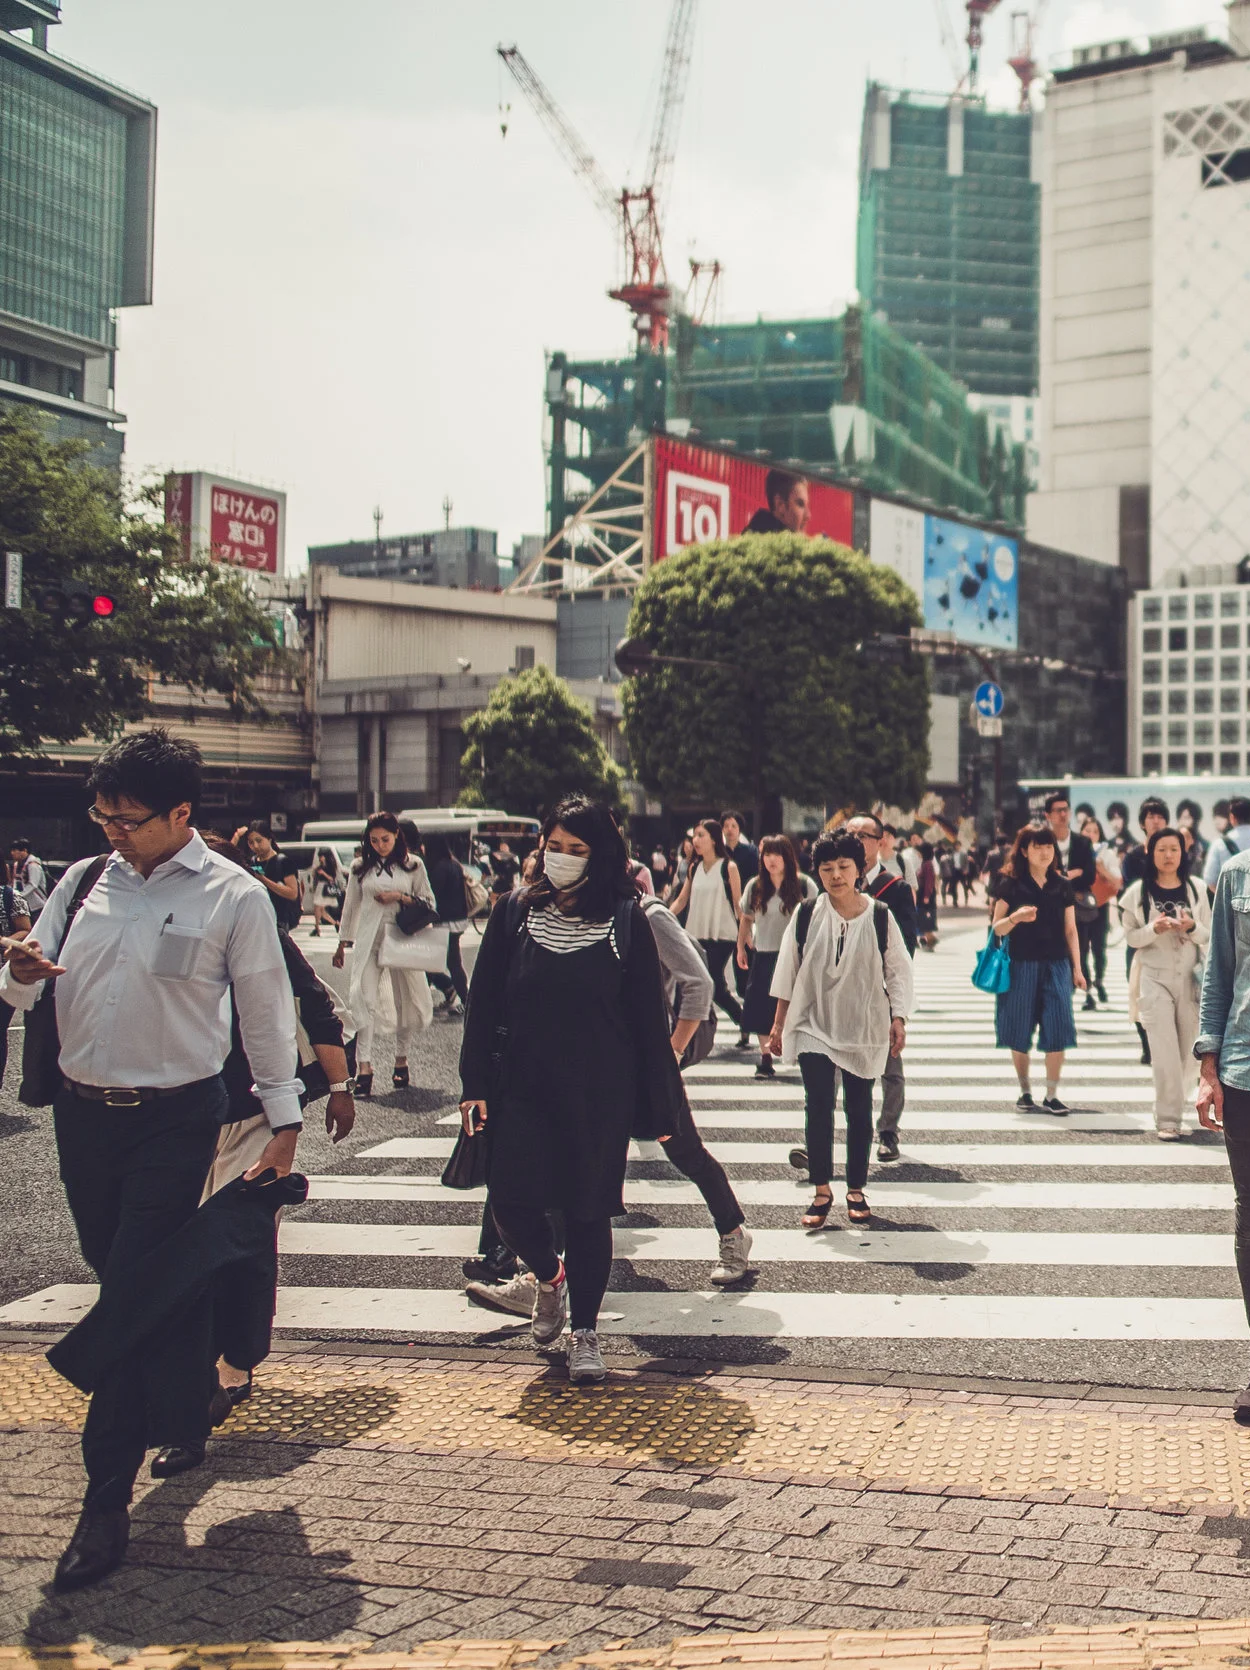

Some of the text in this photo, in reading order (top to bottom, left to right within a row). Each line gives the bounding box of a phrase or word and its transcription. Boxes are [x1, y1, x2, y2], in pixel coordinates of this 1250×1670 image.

[213, 491, 276, 525] ほけんの
[680, 500, 718, 545] 10
